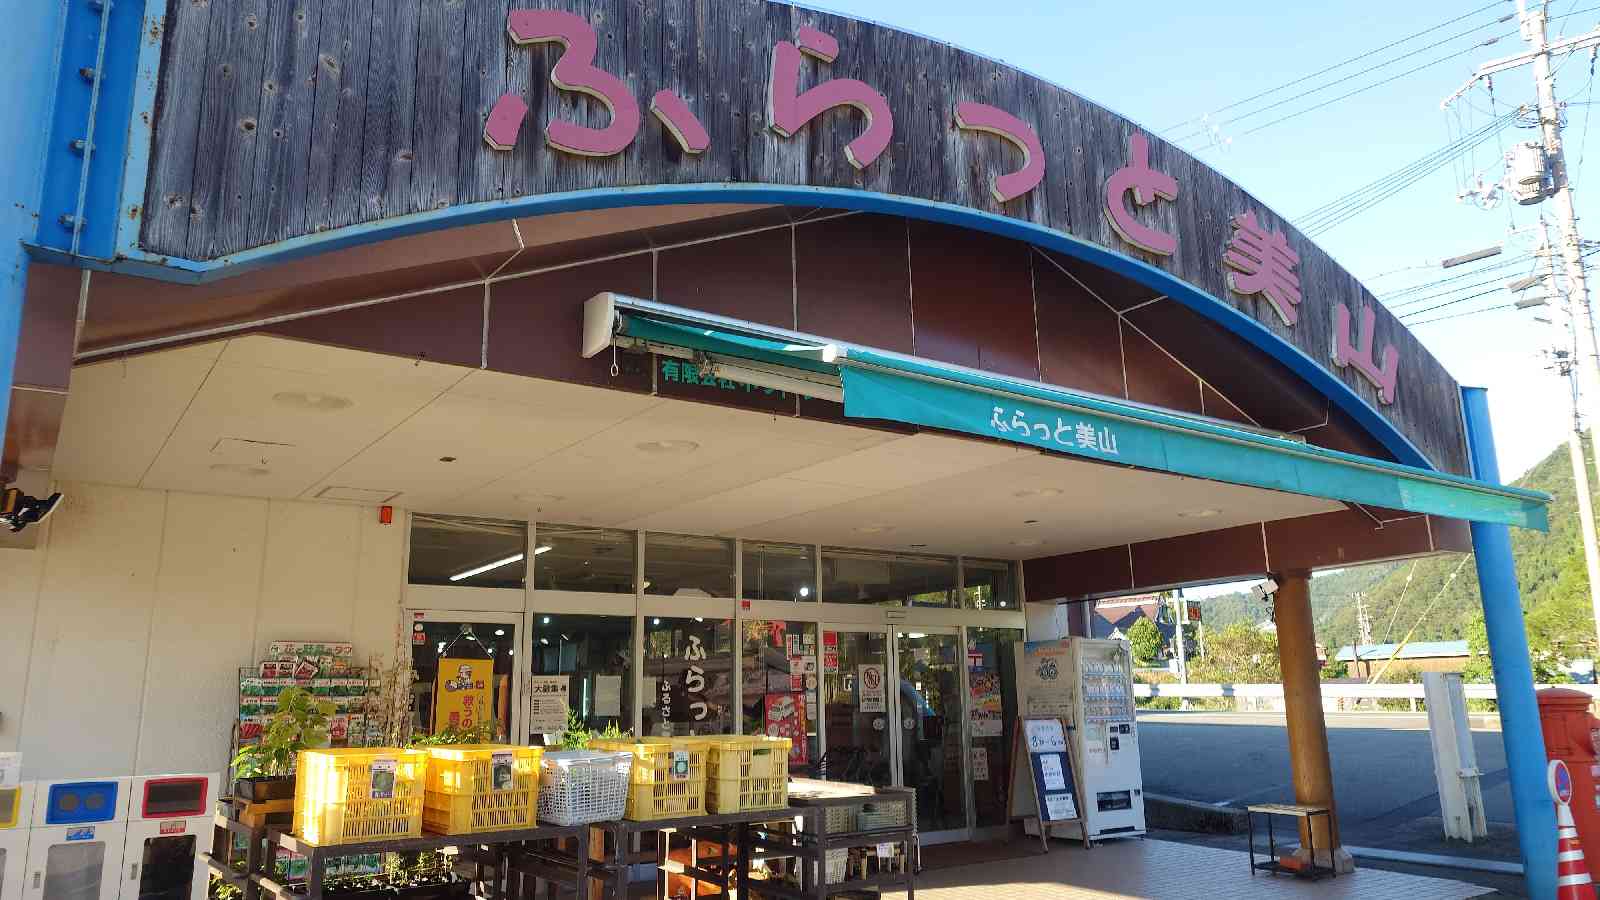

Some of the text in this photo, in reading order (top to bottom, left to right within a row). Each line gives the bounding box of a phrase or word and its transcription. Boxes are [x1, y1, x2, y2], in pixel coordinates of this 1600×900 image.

[484, 8, 1398, 405] ふらっと美山
[990, 406, 1119, 455] ふらっと美山
[661, 680, 672, 736] ふるさと
